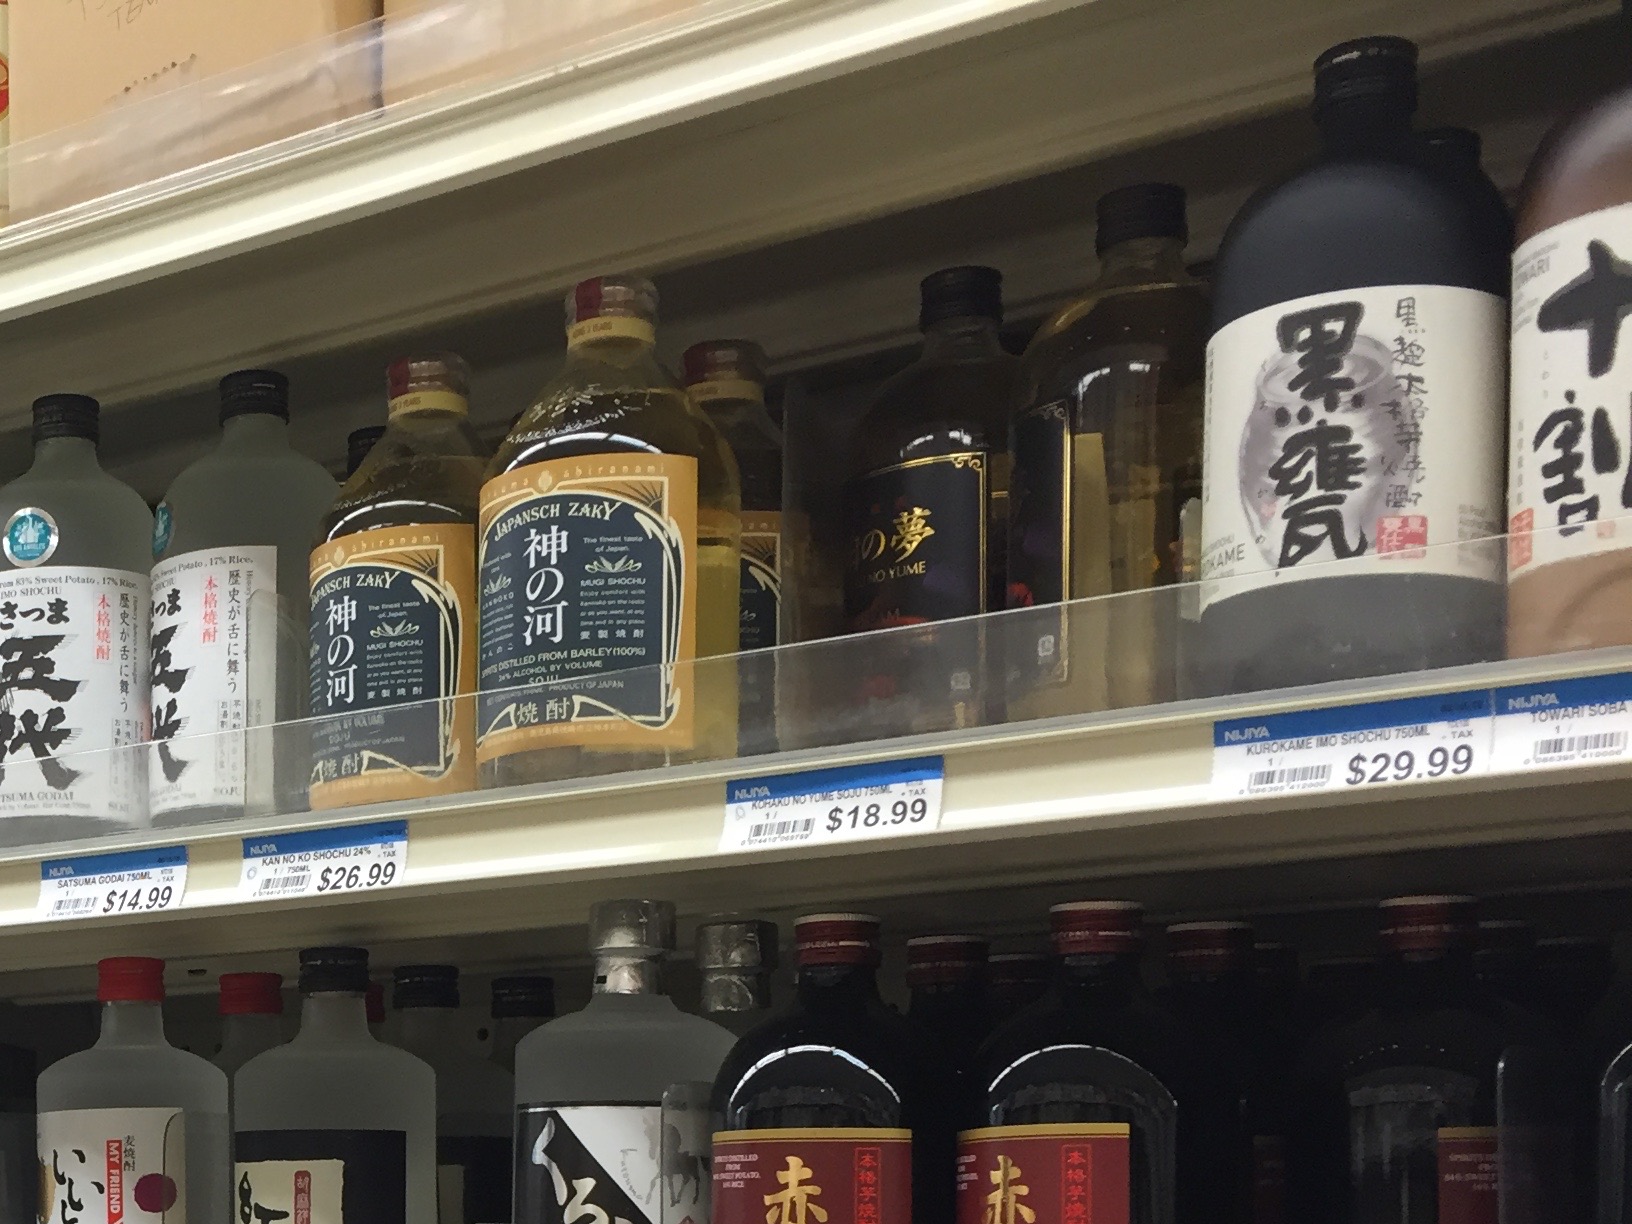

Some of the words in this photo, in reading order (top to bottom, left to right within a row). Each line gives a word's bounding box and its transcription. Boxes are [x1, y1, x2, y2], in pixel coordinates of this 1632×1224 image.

[607, 576, 647, 586] SHOCHU
[888, 560, 927, 580] YUME
[20, 586, 62, 598] SHOCHU
[521, 524, 570, 647] 神の河
[0, 598, 70, 631] さつま
[95, 593, 113, 662] 本格焼酎
[325, 594, 359, 707] 神の河
[537, 649, 568, 662] FROM
[564, 659, 603, 670] VOLUME
[517, 697, 570, 726] 焼酎
[1508, 693, 1560, 712] NIJIYA
[1530, 703, 1586, 724] TOWARI
[1587, 700, 1630, 719] SOBA
[1224, 726, 1270, 744] NIJIYA
[1245, 738, 1314, 757] KUROKAME
[1315, 733, 1338, 750] IMO
[1340, 727, 1392, 747] SHOCHU
[1344, 743, 1475, 786] $29.99
[734, 785, 770, 801] NIJIYA
[751, 796, 791, 811] KOHAKU
[791, 795, 807, 806] NO
[808, 792, 834, 804] YUME
[825, 797, 928, 834] $18.99
[282, 853, 297, 865] NO
[312, 848, 352, 862] SHOCHU
[57, 876, 97, 889] SATSUMA
[98, 873, 125, 886] GODAI
[316, 861, 397, 892] $26.99
[102, 885, 174, 914] $14.99
[108, 1141, 120, 1164] MY
[108, 1168, 121, 1215] FRIEND
